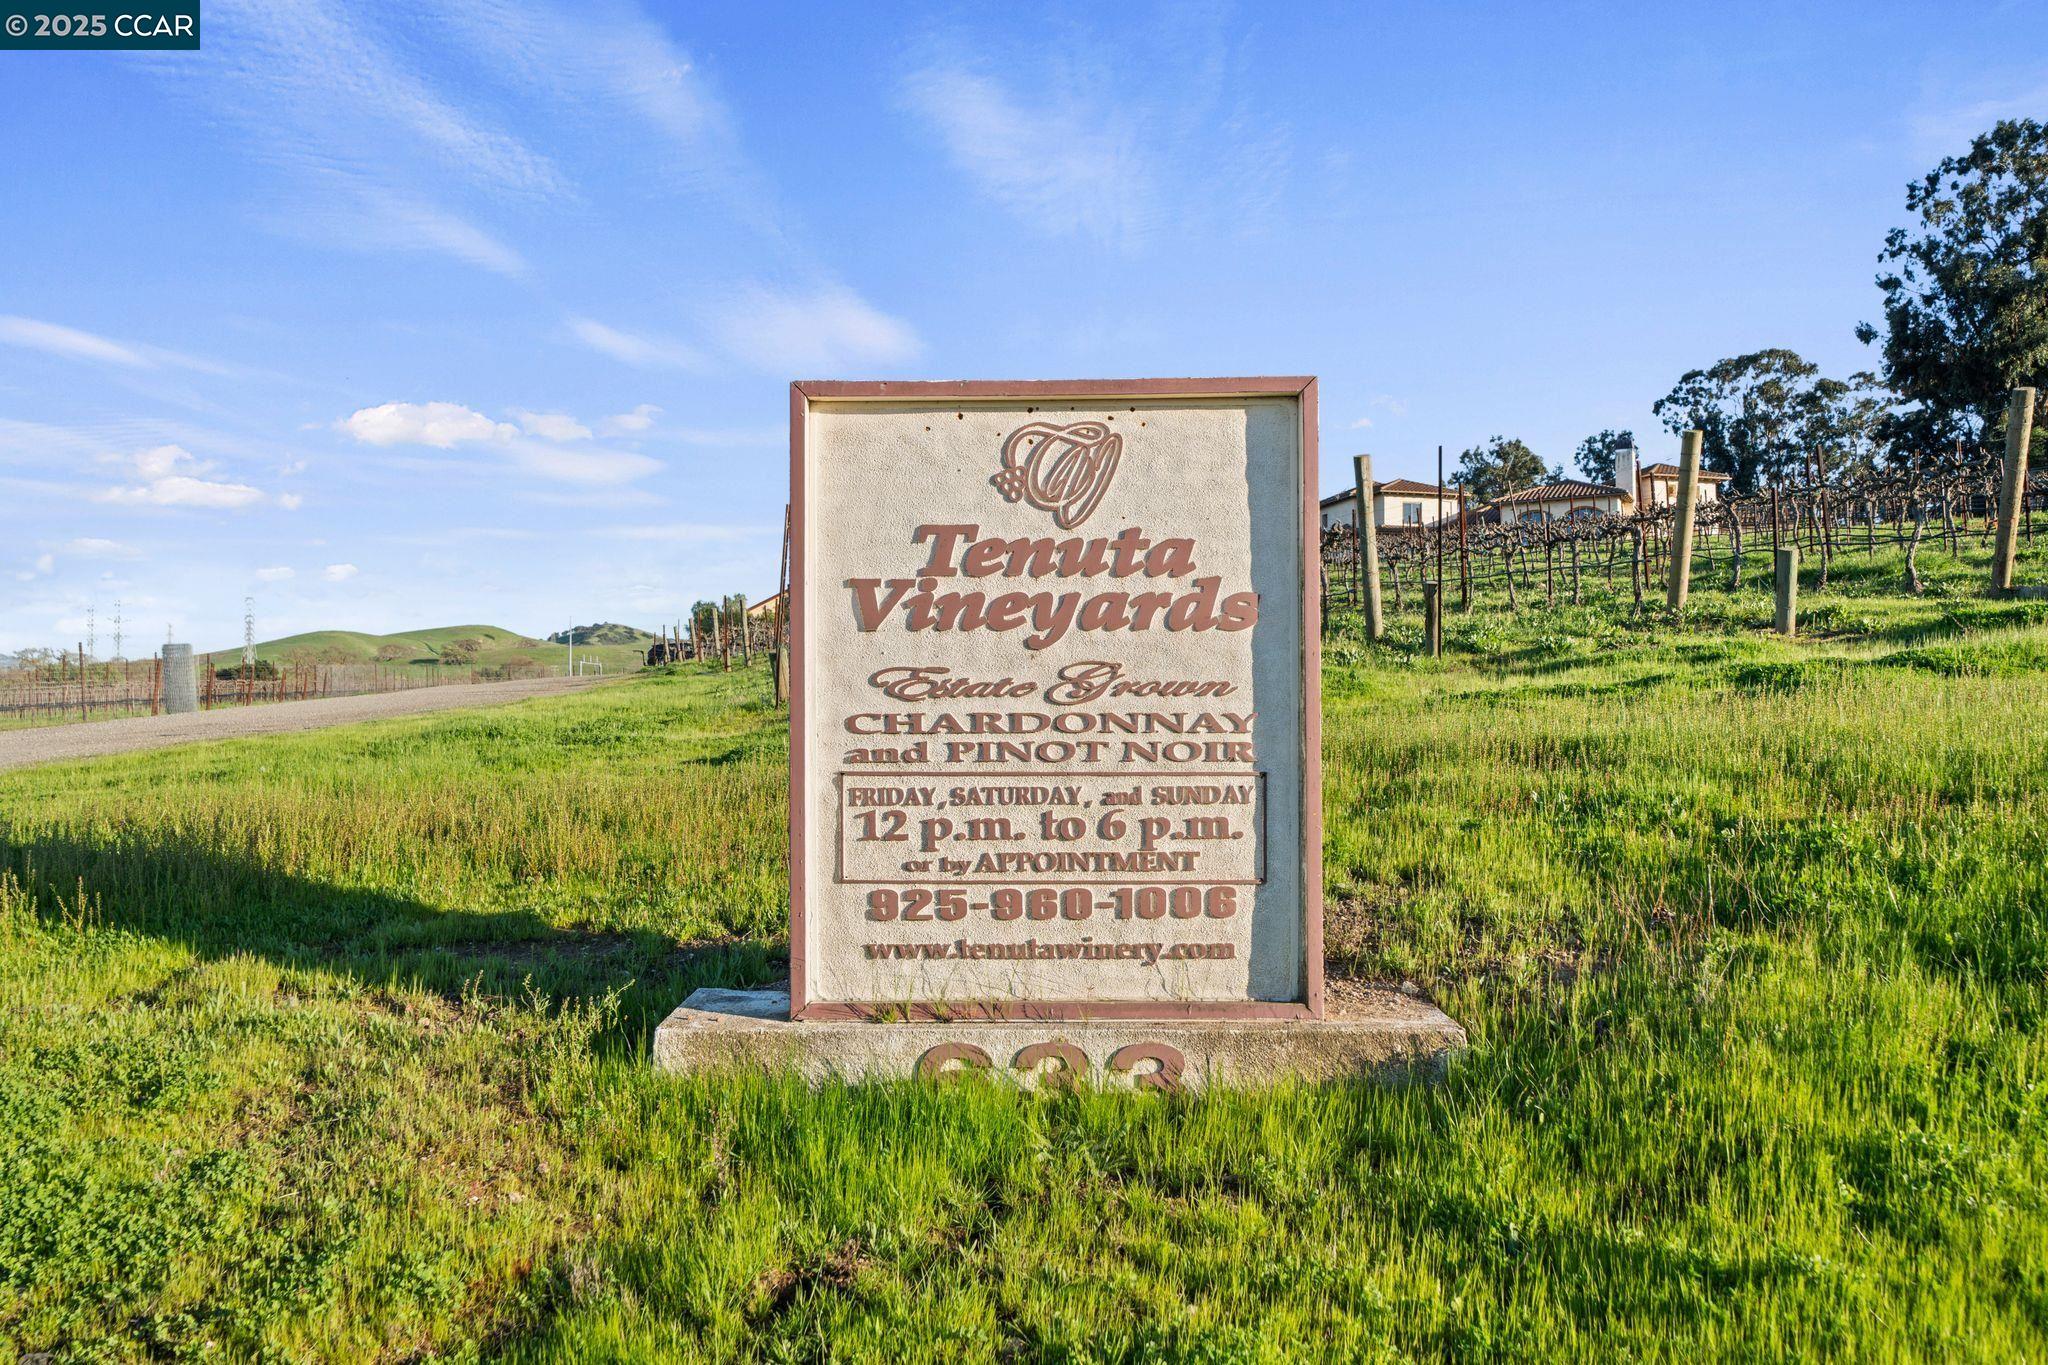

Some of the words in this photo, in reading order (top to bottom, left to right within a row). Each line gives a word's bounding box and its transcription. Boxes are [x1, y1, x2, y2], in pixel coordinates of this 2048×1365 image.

[914, 523, 1197, 578] Tenuta
[847, 575, 1259, 650] Vineyards
[873, 666, 1038, 700] Estate
[1047, 660, 1239, 706] Grown
[846, 711, 1259, 735] CHARDONNAY
[846, 742, 929, 763] and
[947, 741, 1109, 763] PINOT
[1122, 740, 1257, 763] NOIR
[1102, 786, 1143, 805] and
[1152, 785, 1254, 805] SUNDAY
[854, 809, 909, 841] 12
[920, 816, 1027, 852] p.m.
[1041, 810, 1087, 840] to
[1100, 808, 1127, 841] 6
[1139, 816, 1245, 850] p.m.
[903, 859, 934, 872] or
[939, 856, 972, 876] by
[973, 851, 1201, 873] APPOINTMENT
[868, 885, 1237, 921] 925-960-1006
[865, 937, 1236, 966] www.tenutawinery.com
